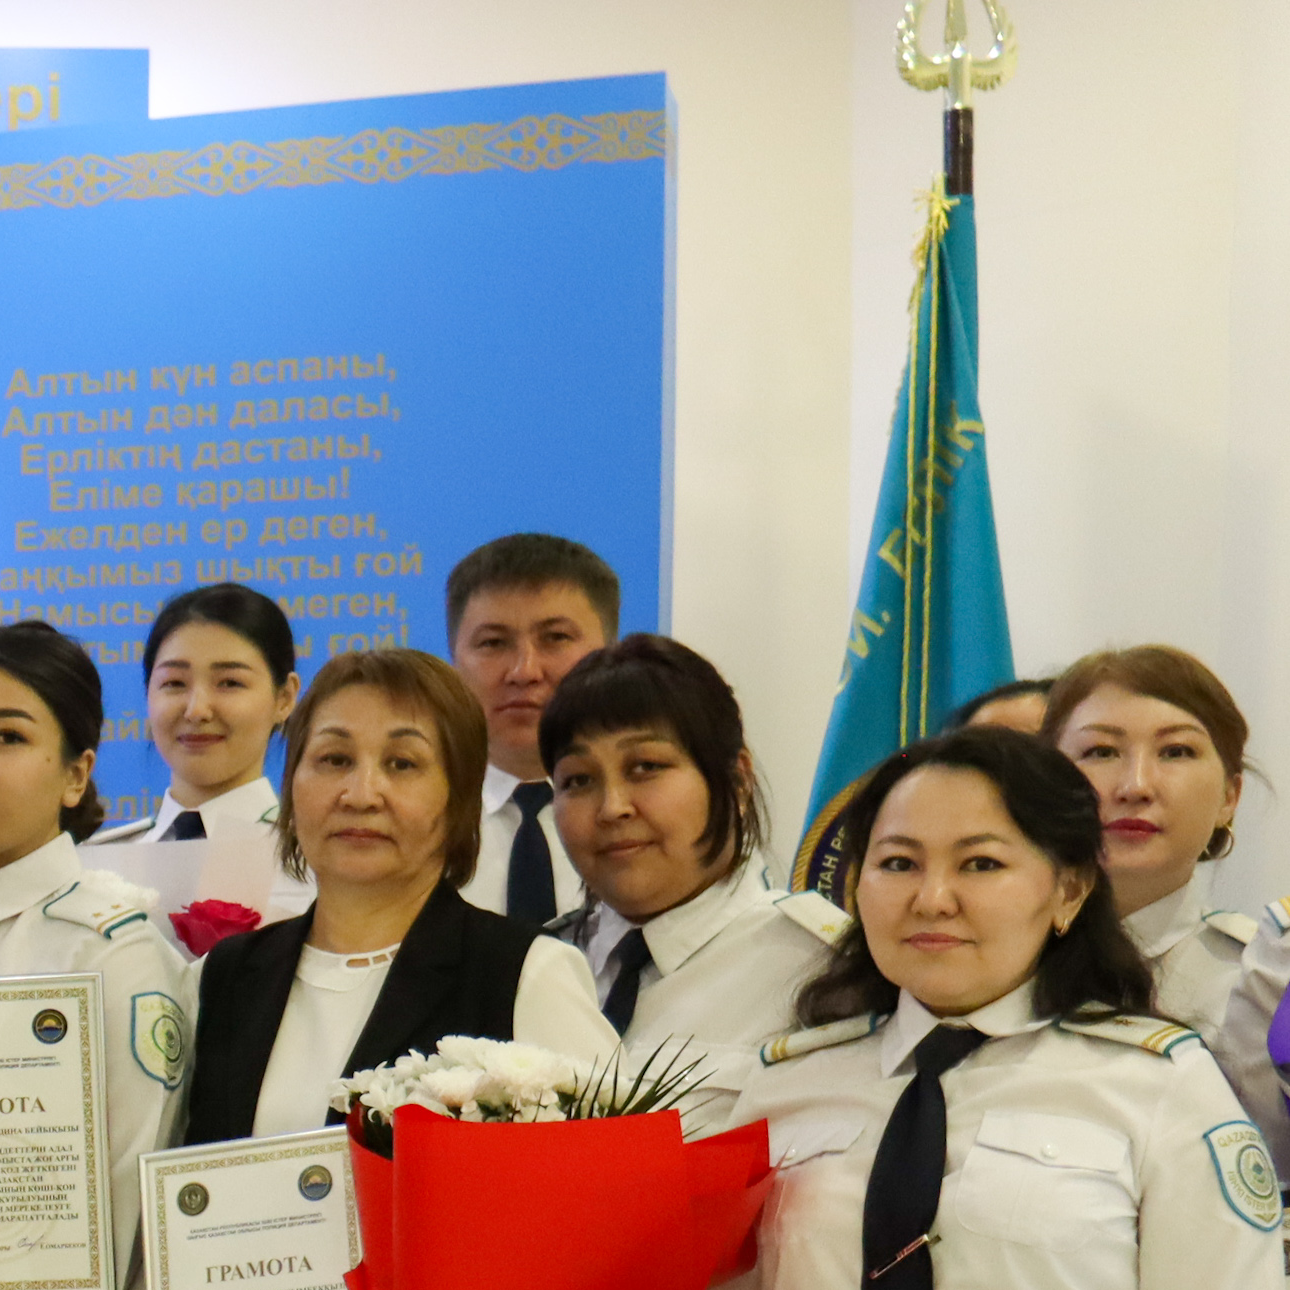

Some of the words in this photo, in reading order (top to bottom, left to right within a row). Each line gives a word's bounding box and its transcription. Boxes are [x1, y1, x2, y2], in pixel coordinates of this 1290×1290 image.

[4, 368, 137, 398] Алтын
[150, 363, 216, 396] күн
[229, 353, 396, 385] аспаны,
[1, 407, 133, 437] Алтын
[144, 403, 218, 434] дән
[229, 393, 400, 429] даласы,
[20, 440, 183, 480] Ерліктің
[192, 434, 381, 470] дастаны,
[49, 479, 162, 512] Еліме
[177, 466, 350, 511] қарашы!
[14, 519, 187, 552] Ежелден
[201, 518, 248, 549] ер
[259, 513, 387, 546] деген,
[196, 553, 341, 583] шықты
[354, 544, 423, 577] ғой
[206, 1255, 313, 1283] ГРАМОТА
